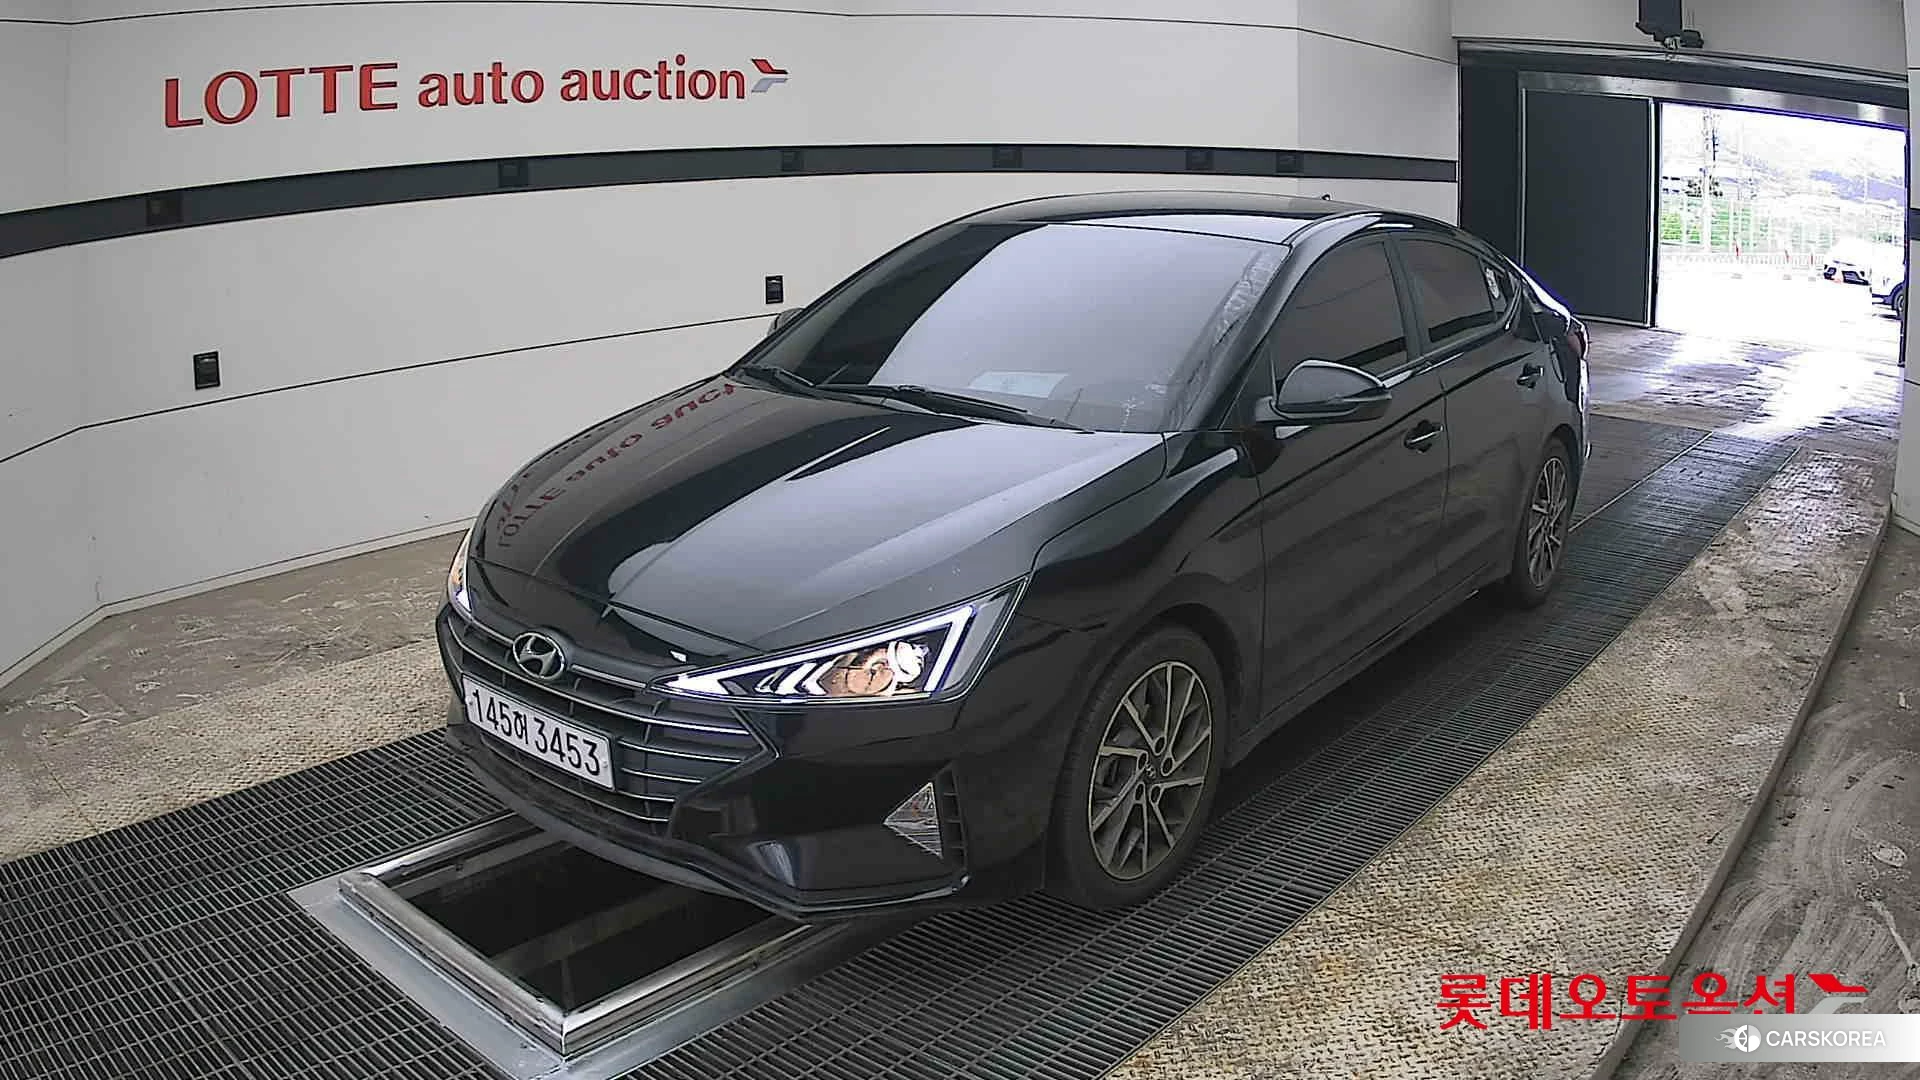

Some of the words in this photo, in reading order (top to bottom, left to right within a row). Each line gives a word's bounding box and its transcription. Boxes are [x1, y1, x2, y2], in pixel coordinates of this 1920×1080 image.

[164, 63, 398, 128] LOTTE
[418, 61, 544, 107] auto
[560, 55, 746, 101] auction
